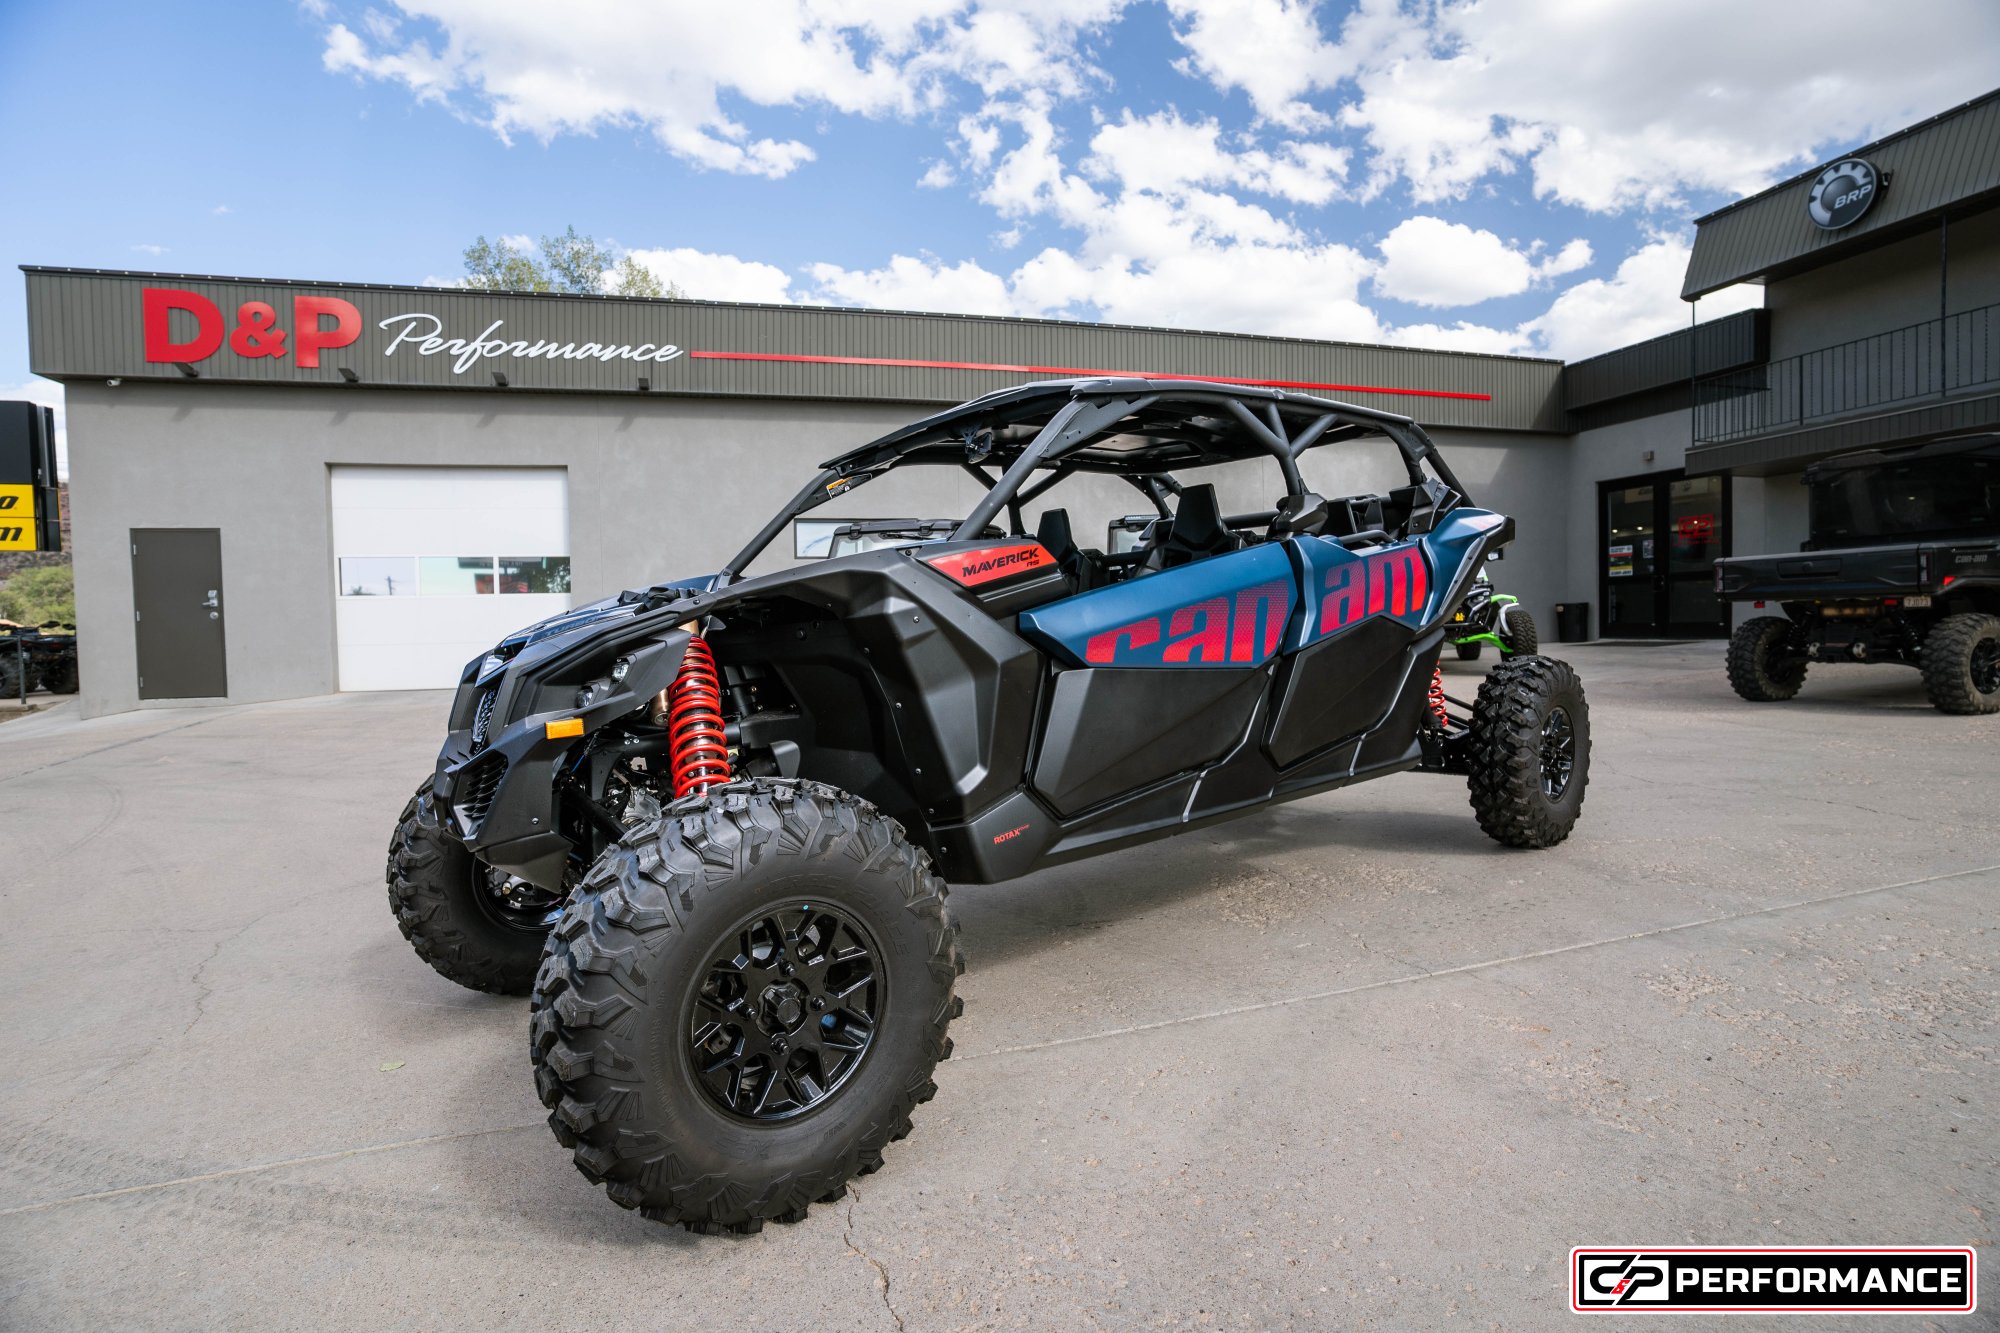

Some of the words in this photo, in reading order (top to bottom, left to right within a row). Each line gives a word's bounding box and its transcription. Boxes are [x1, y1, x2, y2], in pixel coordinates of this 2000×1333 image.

[1834, 184, 1873, 209] BRP
[143, 287, 361, 369] D&P
[379, 313, 684, 374] Performance
[962, 547, 1040, 577] MAVERICK
[993, 829, 1020, 845] ROTAX
